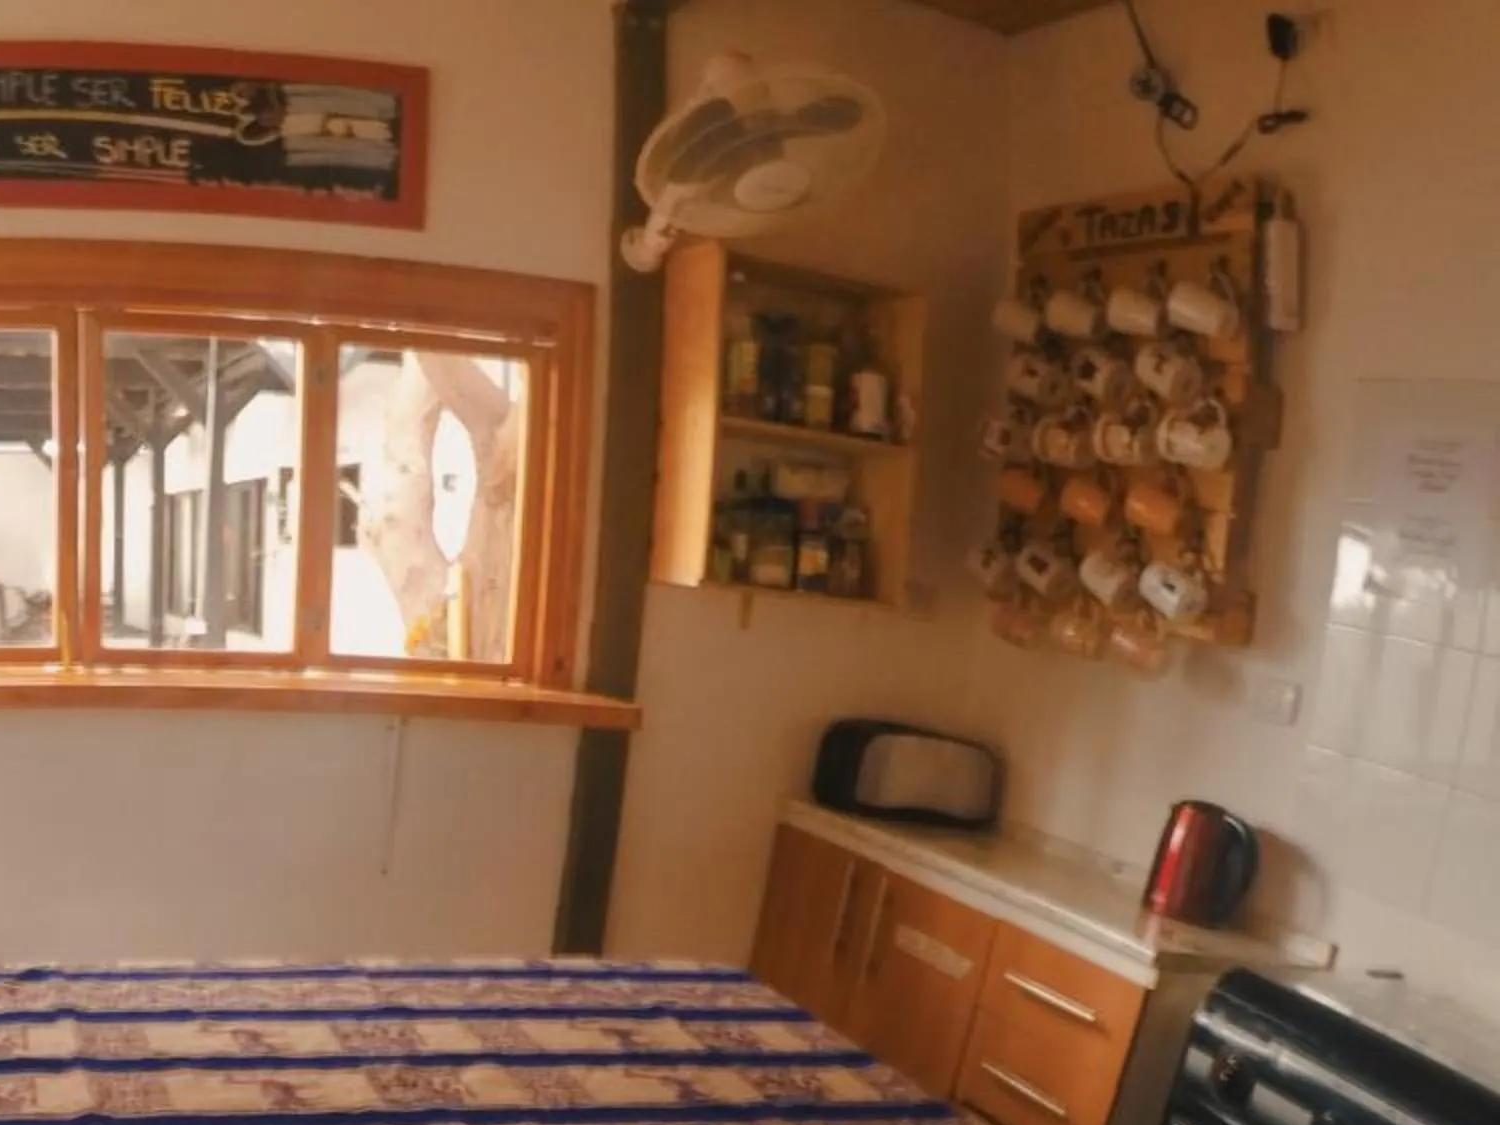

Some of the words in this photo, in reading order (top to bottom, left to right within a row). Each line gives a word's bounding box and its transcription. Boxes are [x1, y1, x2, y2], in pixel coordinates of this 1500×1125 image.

[71, 78, 136, 107] SER
[93, 136, 191, 167] SIMPLE
[1075, 201, 1180, 246] TAZAS
